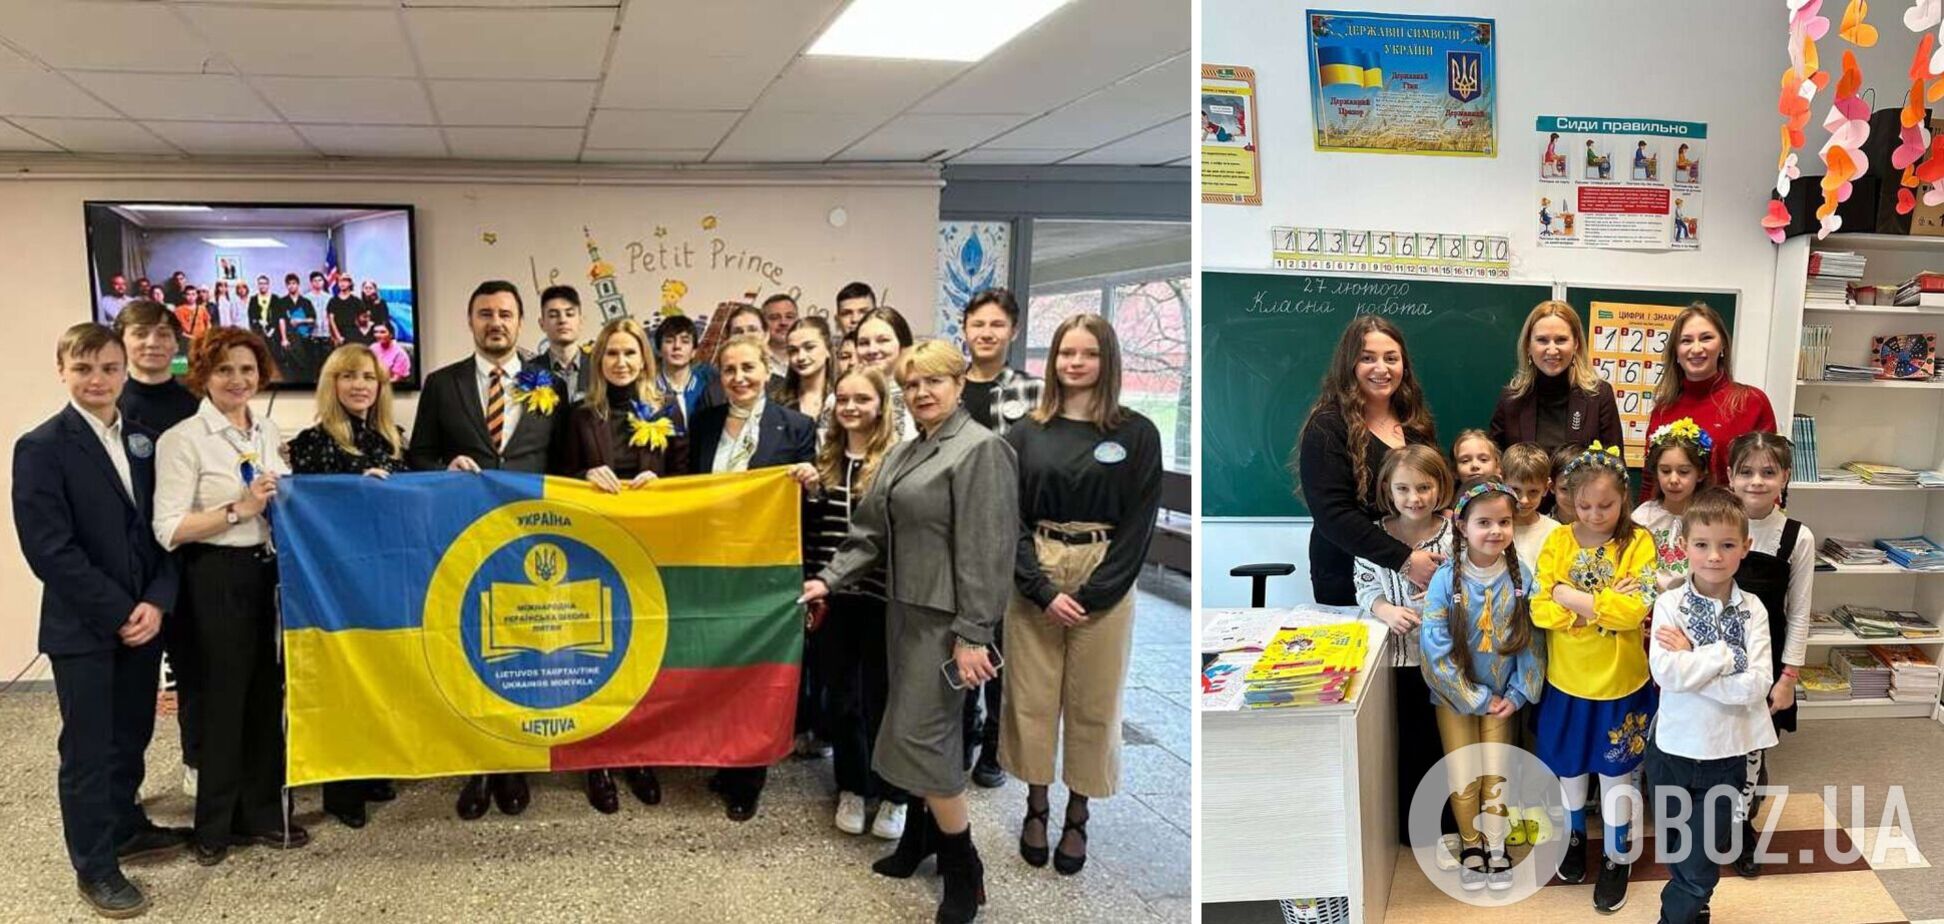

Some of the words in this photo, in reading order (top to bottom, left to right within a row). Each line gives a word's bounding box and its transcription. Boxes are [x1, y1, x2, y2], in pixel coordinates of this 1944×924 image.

[1345, 25, 1404, 39] ДЕРЖАВНІ
[1406, 29, 1460, 40] СИМВОЛИ
[1383, 44, 1434, 56] УКРАЇНИ
[1556, 117, 1598, 131] Сиди
[1602, 120, 1688, 134] правильно
[1285, 231, 1293, 250] 1
[1307, 232, 1319, 252] 2
[1330, 233, 1343, 253] 3
[1352, 234, 1366, 253] 4
[1377, 235, 1390, 254] 5
[1402, 236, 1414, 256] 6
[1426, 237, 1437, 256] 7
[1450, 239, 1461, 258] 8
[1473, 240, 1484, 259] 9
[1496, 240, 1507, 260] 0
[625, 241, 695, 274] Petit
[710, 238, 783, 286] Prince
[1304, 277, 1327, 293] 27
[1331, 282, 1410, 296] лютого
[1246, 290, 1335, 314] Класна
[1354, 297, 1432, 321] робота
[1618, 311, 1645, 320] ЦИФРИ
[1605, 329, 1617, 350] 1
[1631, 330, 1643, 352] 2
[1653, 332, 1669, 353] 3
[1600, 361, 1615, 380] 5
[1625, 362, 1640, 383] 6
[1654, 363, 1664, 384] 7
[1624, 392, 1638, 413] 0
[517, 511, 572, 527] УКРАЇНА
[495, 669, 539, 679] LIETUVOS
[522, 718, 576, 737] LIETUVA
